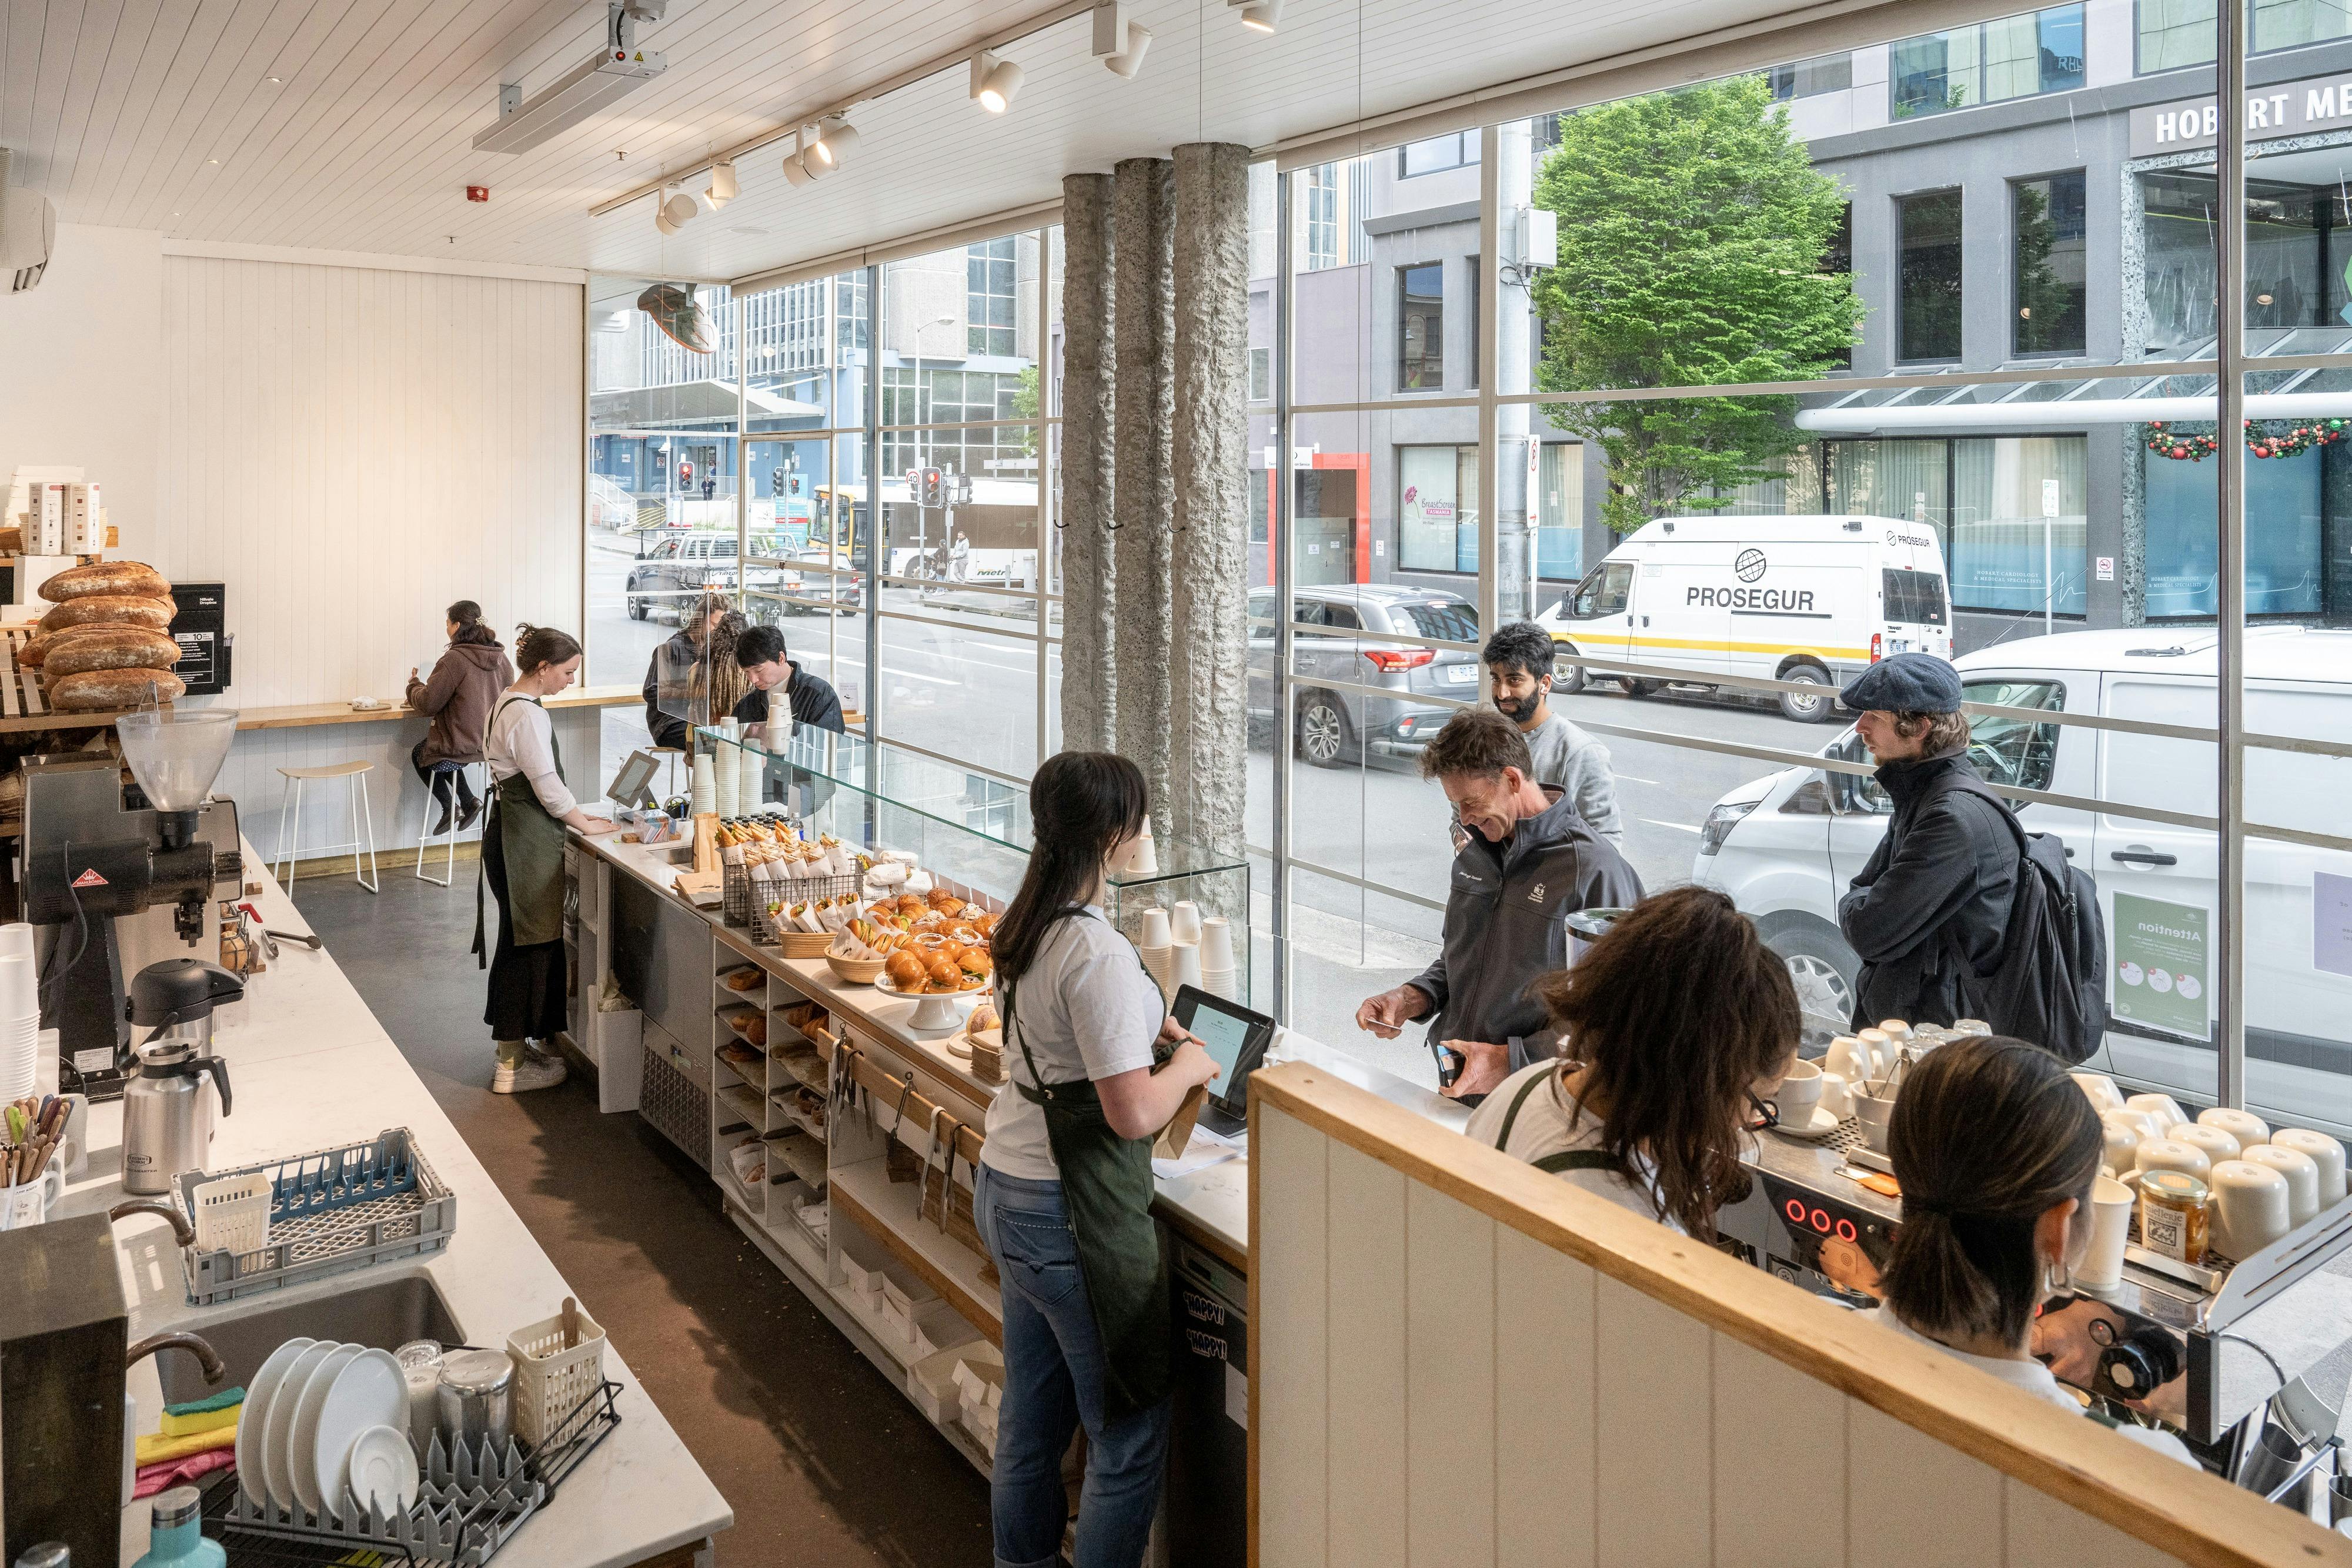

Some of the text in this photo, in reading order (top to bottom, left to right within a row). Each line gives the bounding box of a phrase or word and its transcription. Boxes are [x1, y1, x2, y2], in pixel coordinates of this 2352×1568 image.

[2156, 94, 2288, 143] HOBRT
[1422, 498, 1456, 508] BreastScreen
[1898, 535, 1930, 547] PROSEGUR
[1686, 587, 1814, 611] PROSEGUR
